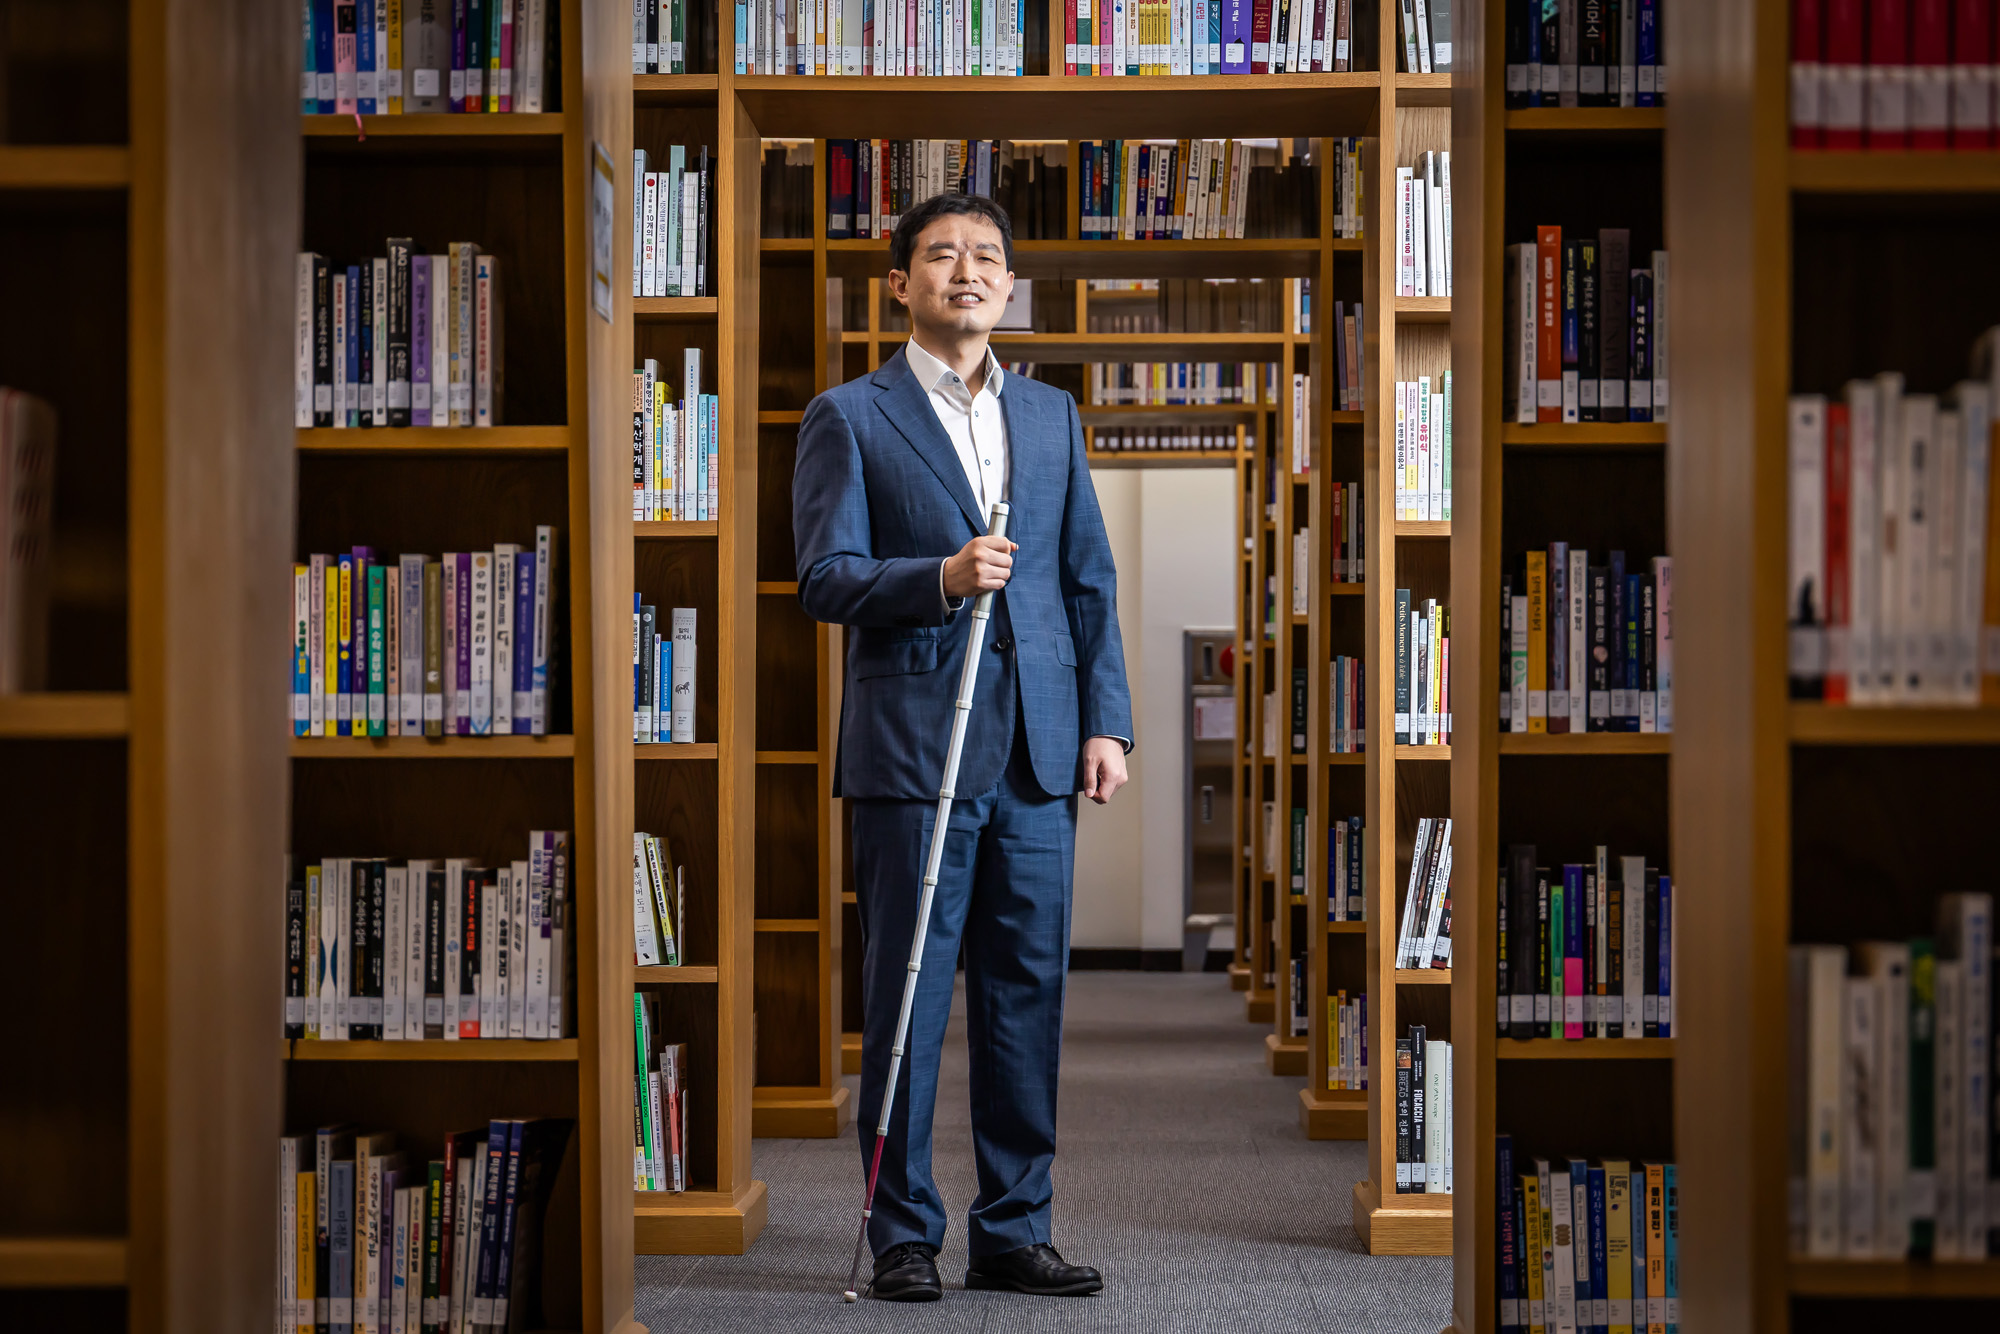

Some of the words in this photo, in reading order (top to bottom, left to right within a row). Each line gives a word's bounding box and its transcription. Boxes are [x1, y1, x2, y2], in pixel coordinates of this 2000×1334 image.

[946, 144, 960, 170] PALO
[398, 246, 408, 266] AIQ
[634, 416, 643, 479] 축산학개론
[543, 850, 553, 876] How
[542, 888, 552, 916] Prove
[1399, 1100, 1408, 1116] 빵의
[1414, 1089, 1423, 1123] FOCACCIA
[1399, 1119, 1408, 1136] 진화
[1528, 1198, 1537, 1214] 세계
[334, 1210, 348, 1250] 미적분
[1530, 1216, 1538, 1240] 물리학
[1531, 1242, 1540, 1266] 필독서
[1532, 1268, 1540, 1278] 30
